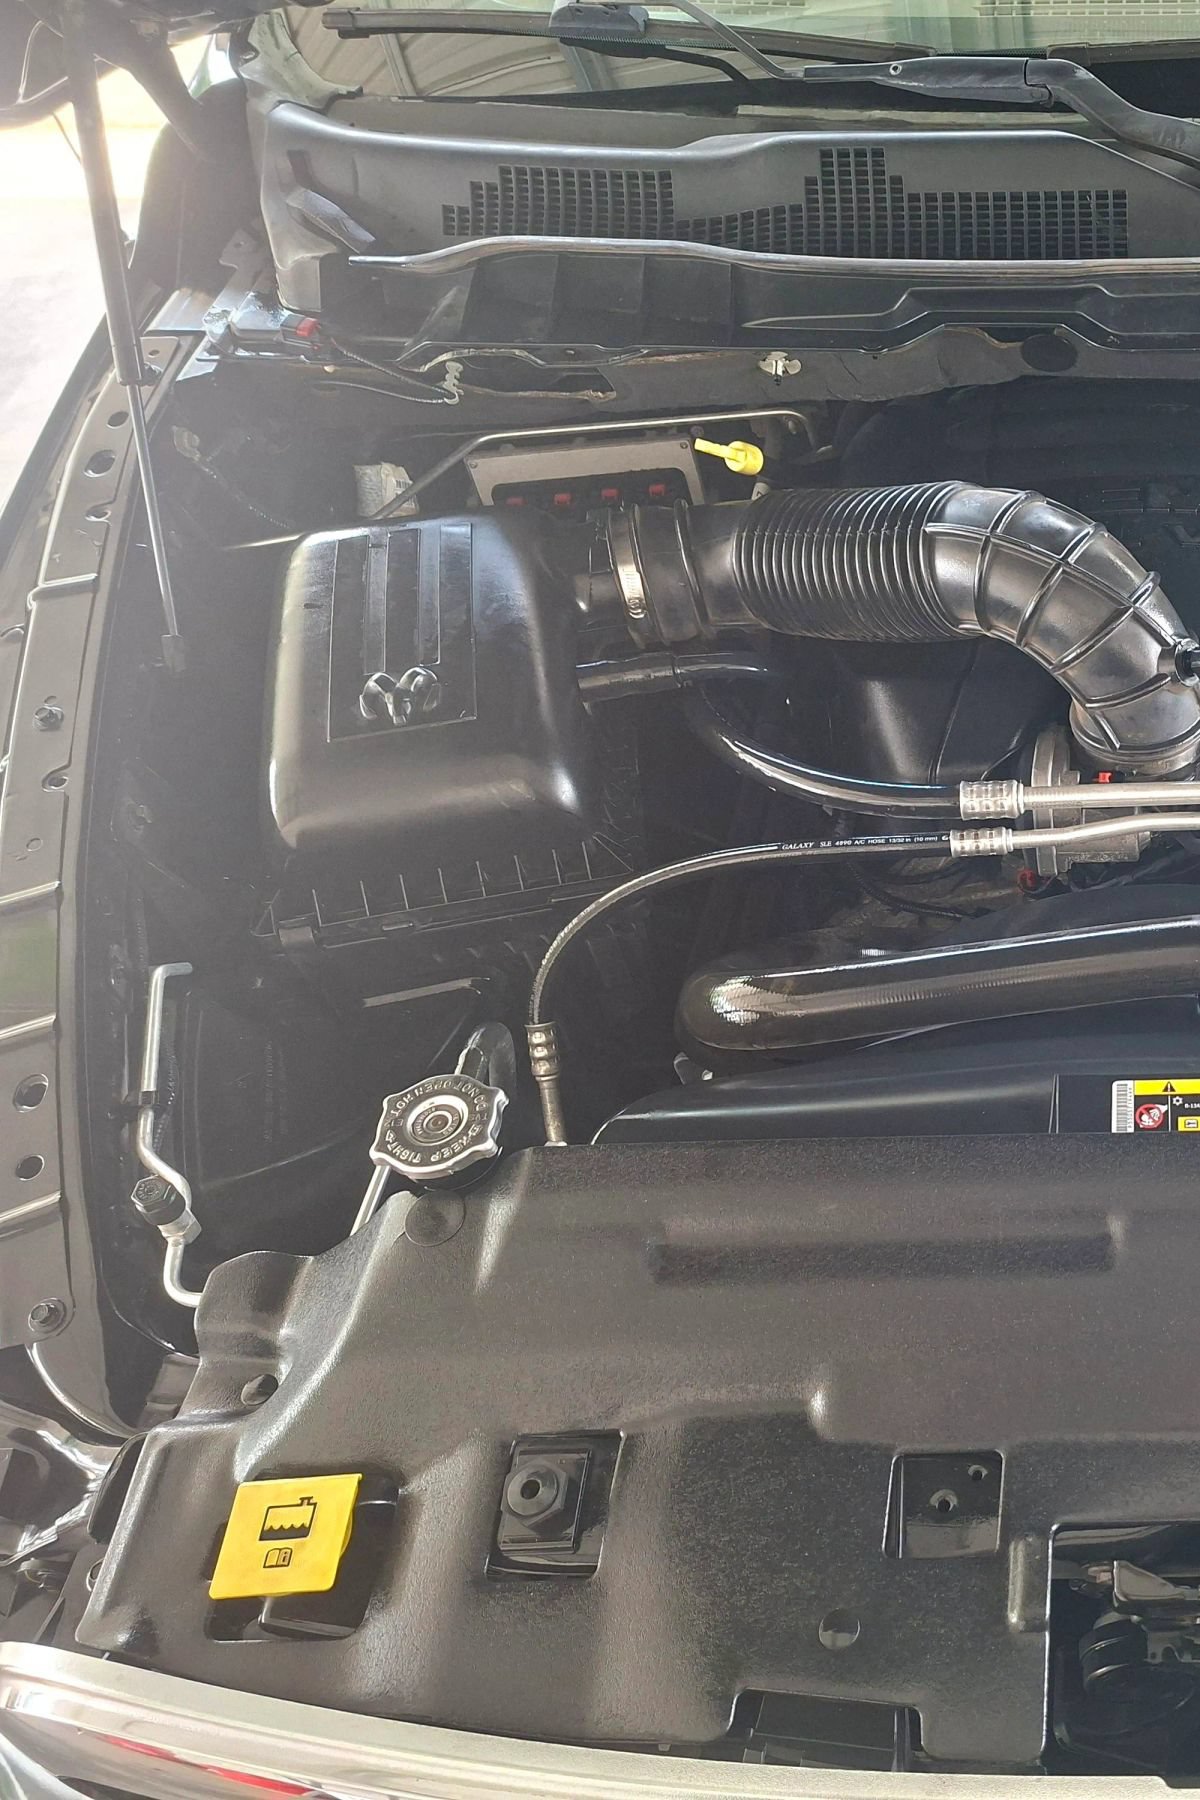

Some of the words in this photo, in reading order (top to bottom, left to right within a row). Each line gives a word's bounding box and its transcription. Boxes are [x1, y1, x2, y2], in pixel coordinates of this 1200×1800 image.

[782, 841, 815, 850] GALAXY
[414, 1081, 451, 1096] OPEN
[390, 1096, 413, 1116] HOT
[387, 1143, 422, 1164] TIGHT
[430, 1134, 472, 1162] KEEP
